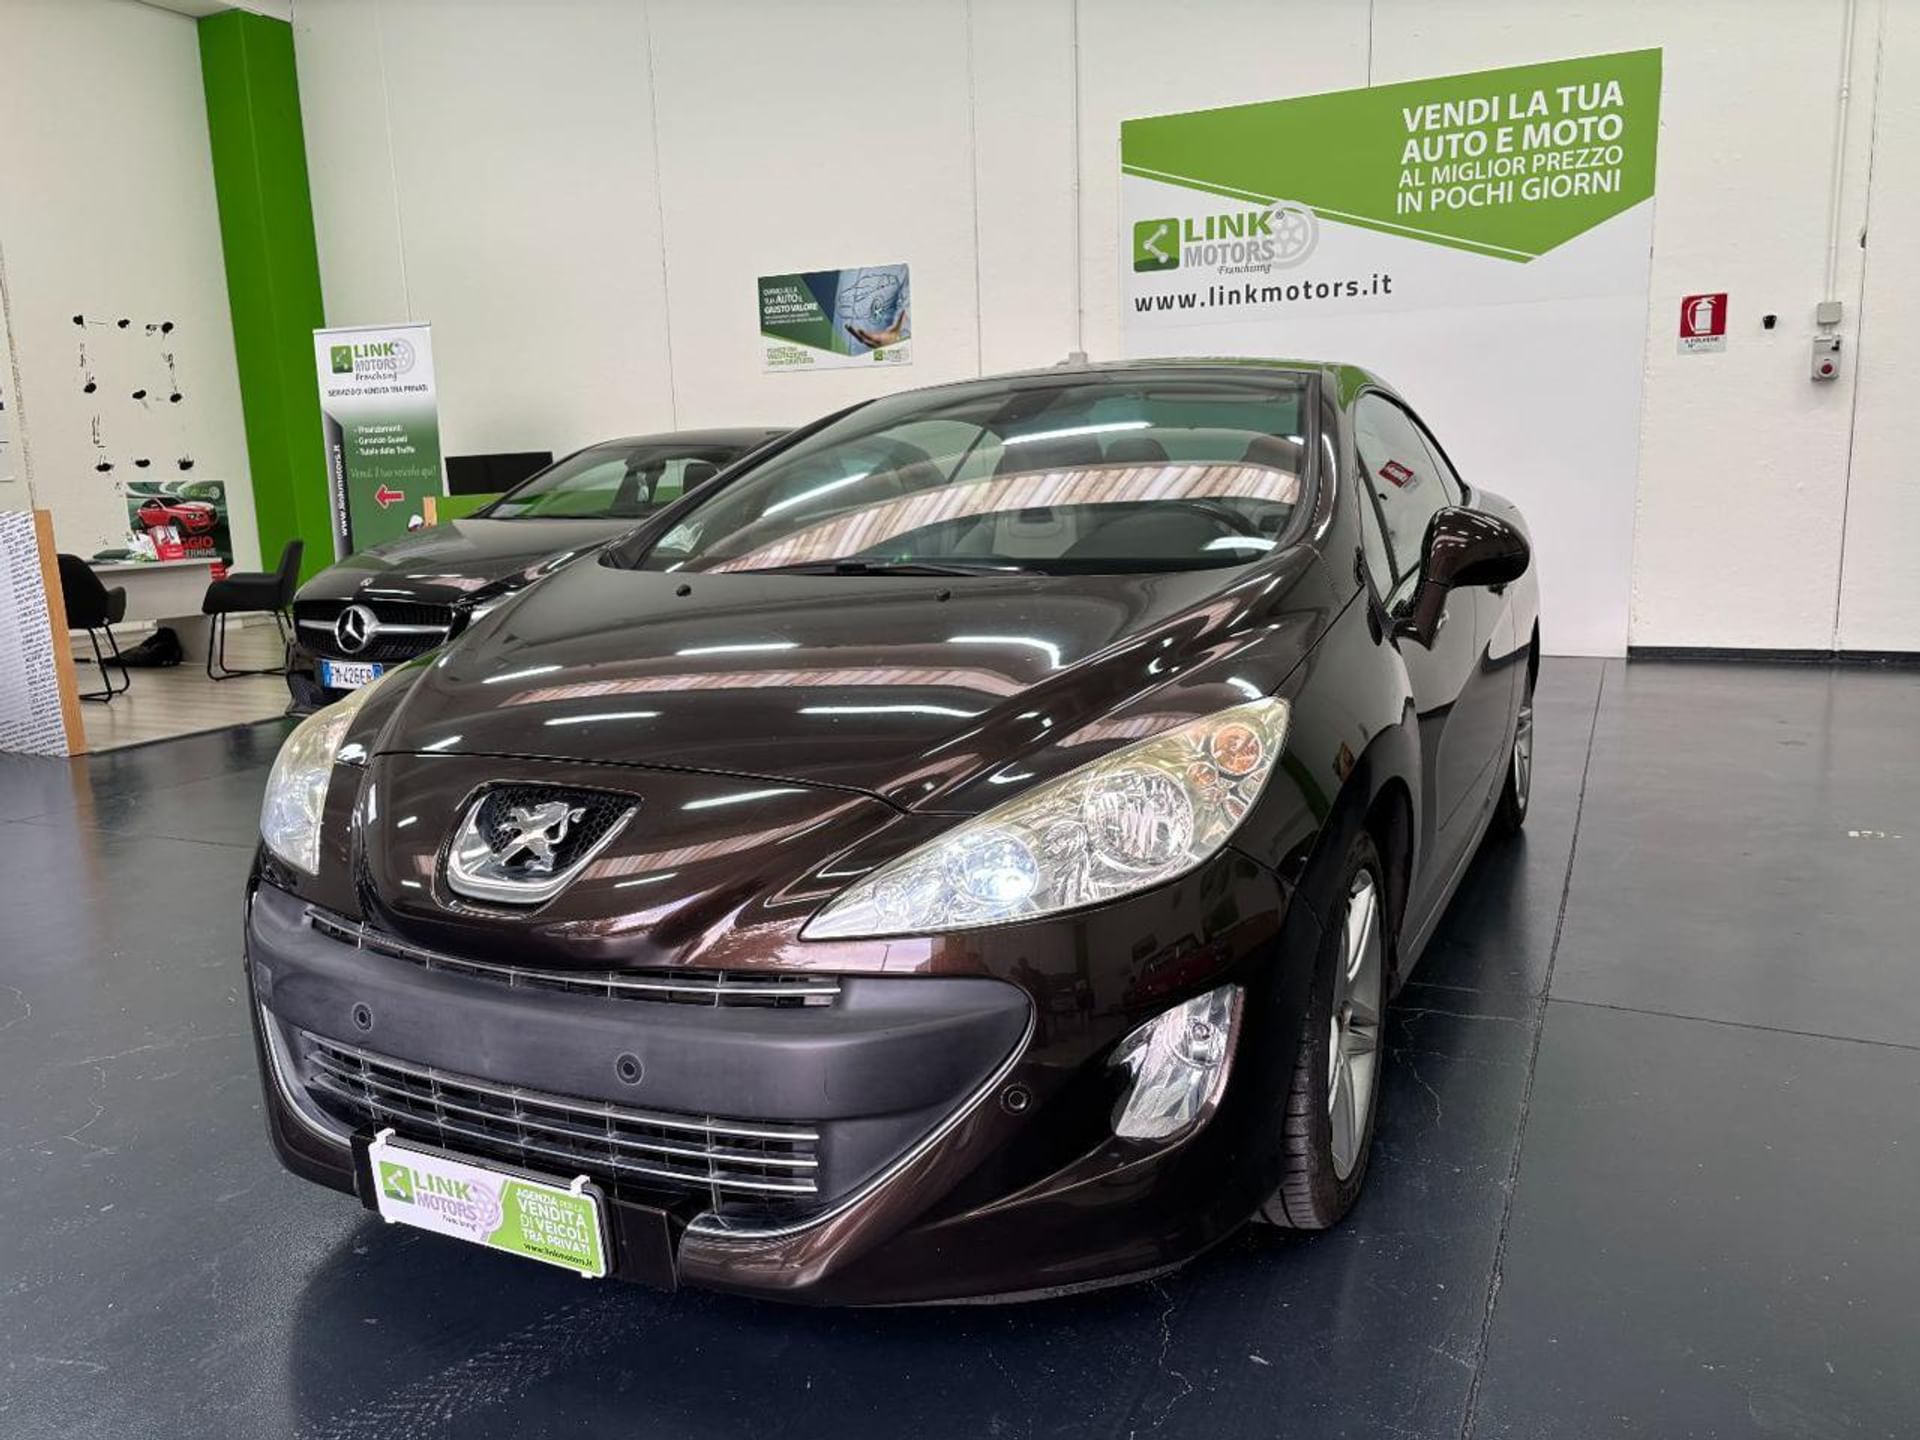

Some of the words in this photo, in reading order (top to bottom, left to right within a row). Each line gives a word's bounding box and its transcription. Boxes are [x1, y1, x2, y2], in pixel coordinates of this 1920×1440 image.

[1403, 96, 1499, 132] VENDI
[1509, 90, 1549, 120] LA
[1556, 80, 1624, 113] TUA
[1401, 130, 1487, 165] AUTO
[1496, 127, 1513, 153] E
[1522, 113, 1623, 150] MOTO
[1398, 168, 1425, 188] AL
[1431, 156, 1526, 184] MIGLIOR
[1532, 145, 1623, 173] PREZZO
[1397, 190, 1423, 214] IN
[1431, 180, 1512, 211] POCHI
[1521, 168, 1621, 200] GIORNI
[1184, 210, 1273, 242] LINK
[1184, 239, 1275, 268] MOTORS
[776, 294, 798, 304] AUTO
[1135, 273, 1392, 312] www.linkmotors.it
[354, 342, 395, 358] LINK
[354, 358, 397, 372] MOTORS
[414, 1170, 472, 1202] LINK
[416, 1191, 477, 1220] MOTORS
[517, 1198, 587, 1228] VENDITA
[520, 1214, 533, 1228] DI
[535, 1217, 589, 1244] VEICOLI
[522, 1228, 545, 1244] TRA
[547, 1236, 591, 1256] PRIVATI
